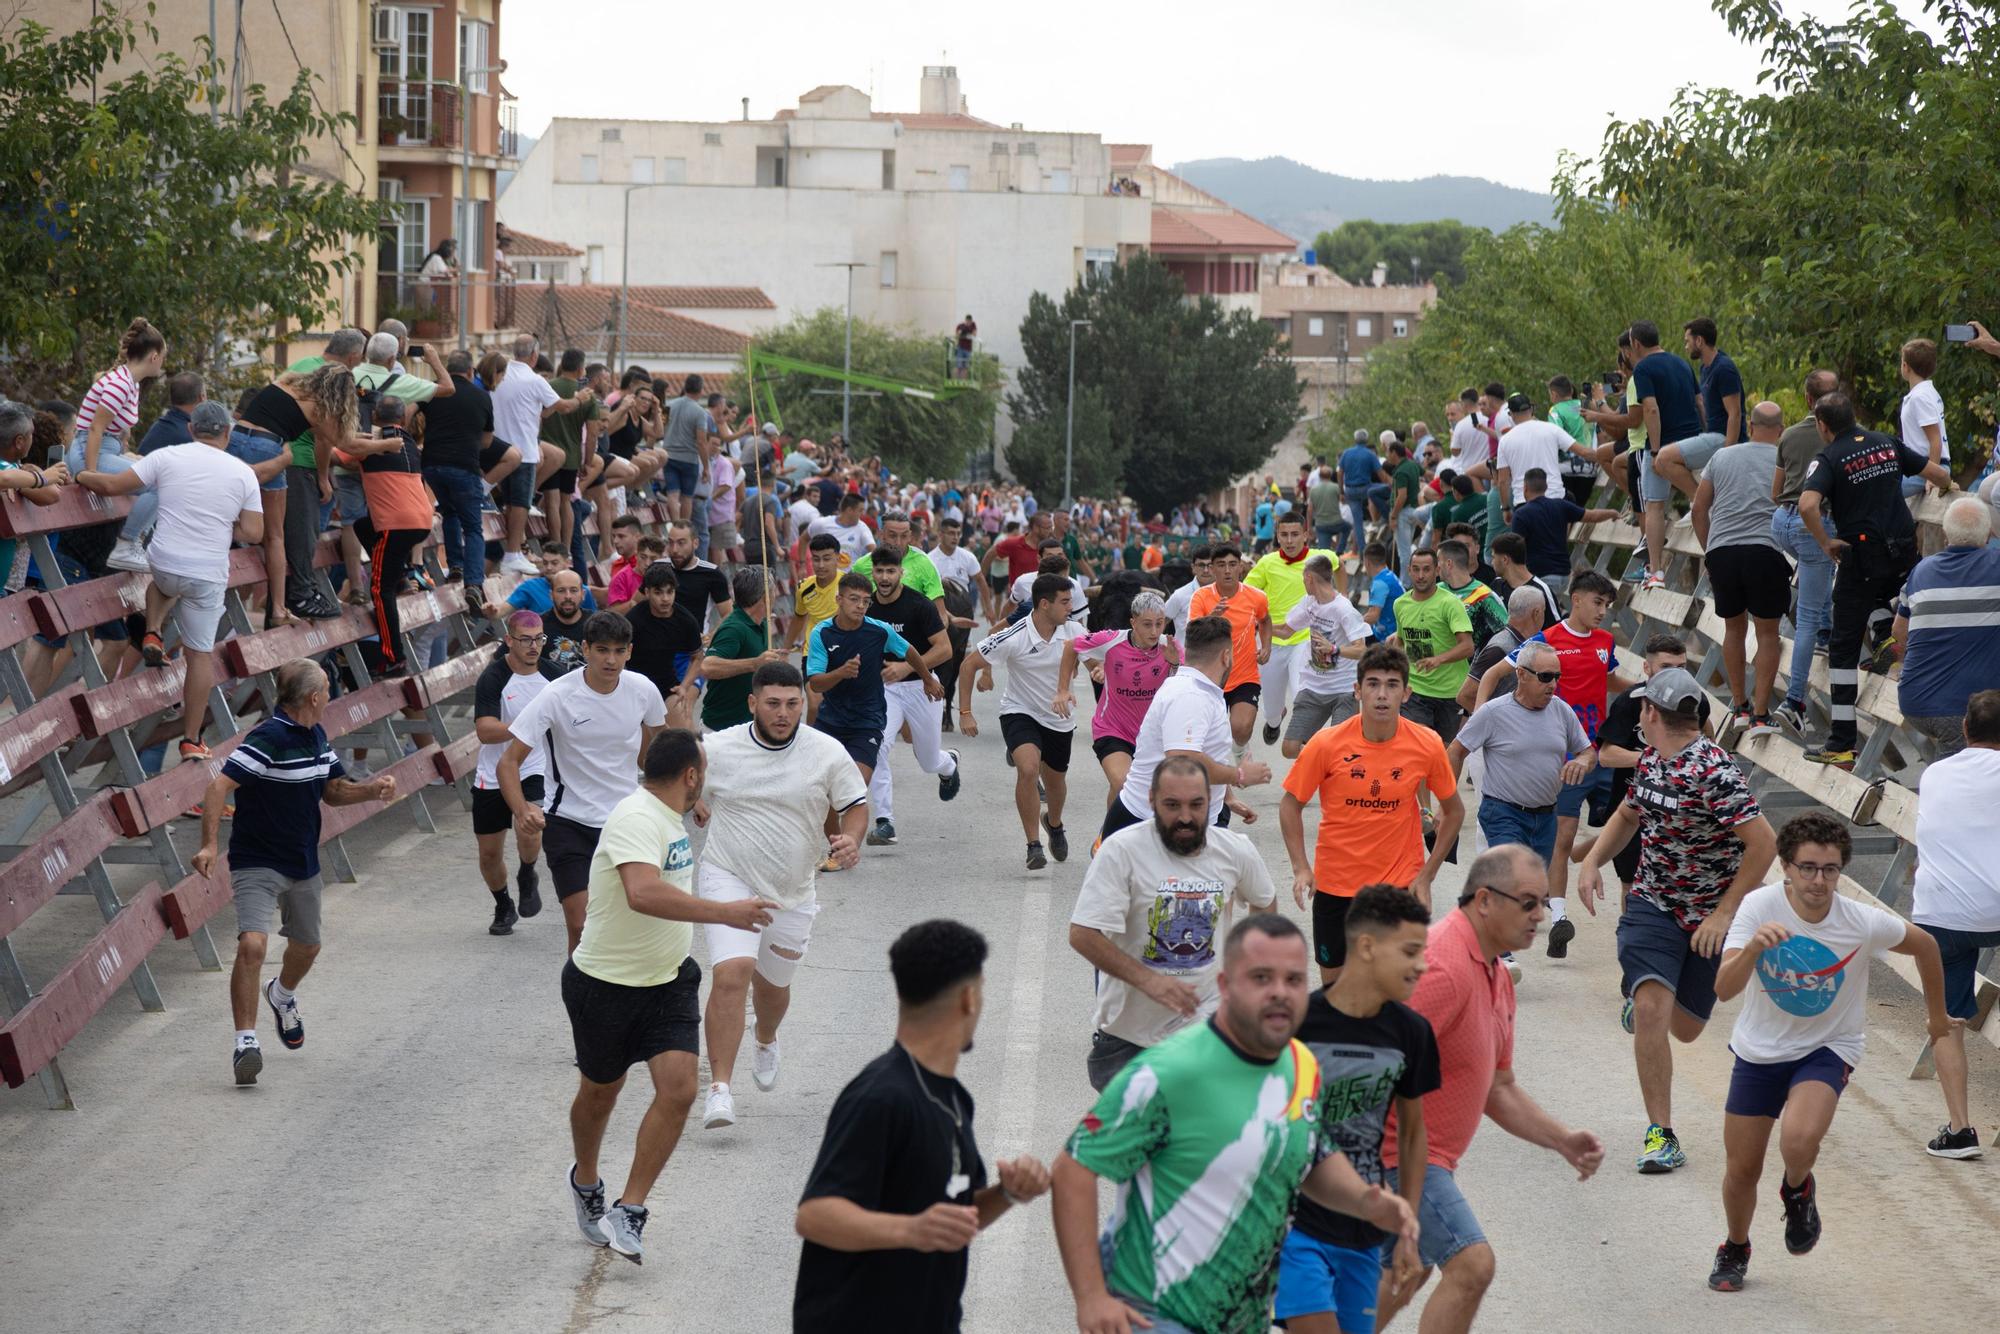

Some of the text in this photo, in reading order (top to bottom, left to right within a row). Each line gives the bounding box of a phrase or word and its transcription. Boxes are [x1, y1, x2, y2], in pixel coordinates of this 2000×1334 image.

[1845, 458, 1867, 473] 112
[1852, 466, 1898, 484] CALASPARRA
[1116, 687, 1157, 698] ortodent
[1345, 797, 1400, 809] ortodent
[1650, 791, 1664, 805] FOR
[1664, 795, 1678, 809] YOU
[1762, 958, 1836, 992] NASA
